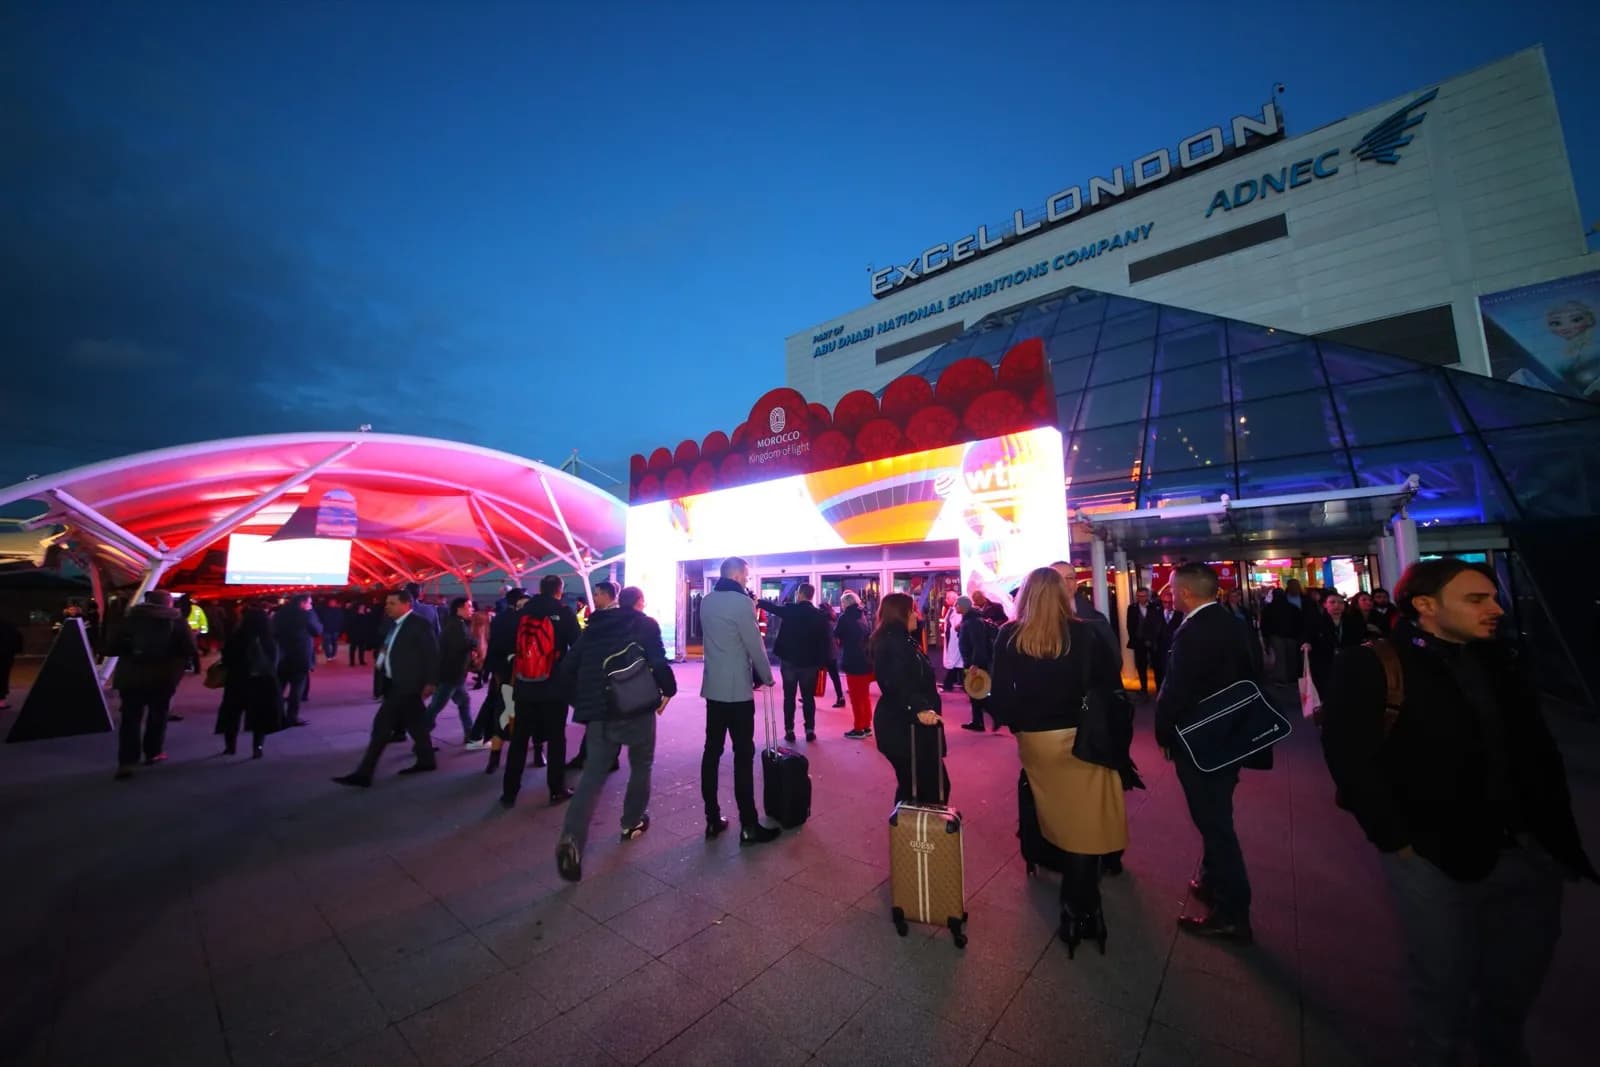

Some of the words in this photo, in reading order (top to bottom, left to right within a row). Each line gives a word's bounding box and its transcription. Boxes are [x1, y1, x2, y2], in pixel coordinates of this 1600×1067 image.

[1013, 101, 1279, 236] LONDON
[1205, 148, 1340, 218] ADNEC
[813, 340, 837, 358] ABU
[838, 326, 875, 350] DHABI
[877, 300, 945, 335] NATIONAL
[947, 260, 1049, 310] EXHIBITIONS
[1052, 222, 1155, 271] COMPANY
[813, 327, 832, 344] PART
[834, 325, 845, 337] OF
[748, 449, 780, 464] Kingdom
[791, 441, 810, 456] light
[757, 430, 800, 448] MOROCCO
